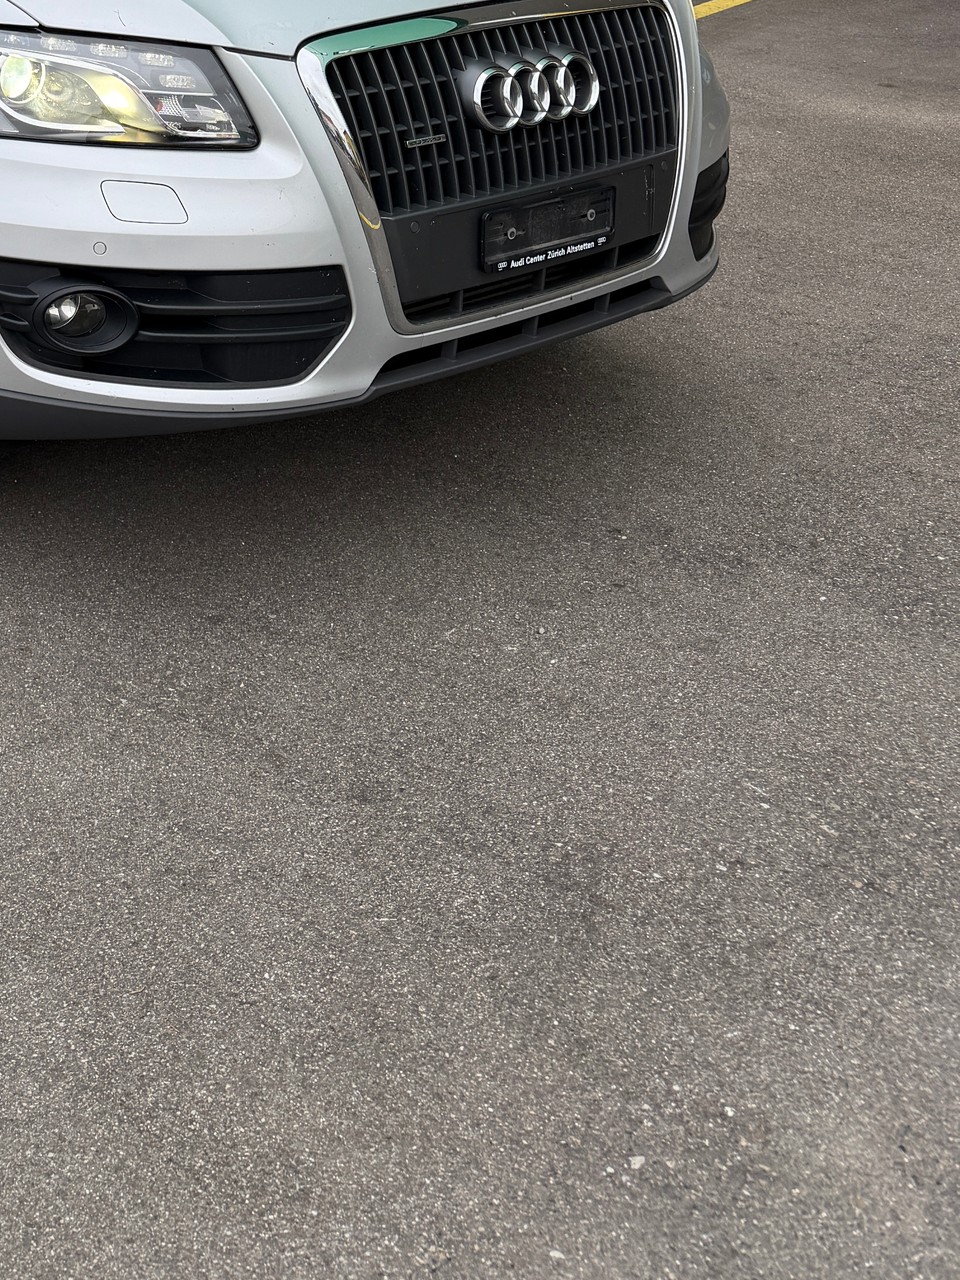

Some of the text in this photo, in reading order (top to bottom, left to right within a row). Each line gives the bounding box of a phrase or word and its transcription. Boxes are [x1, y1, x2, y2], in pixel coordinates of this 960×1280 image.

[510, 241, 595, 268] Audi Center Zürich Altstetten
